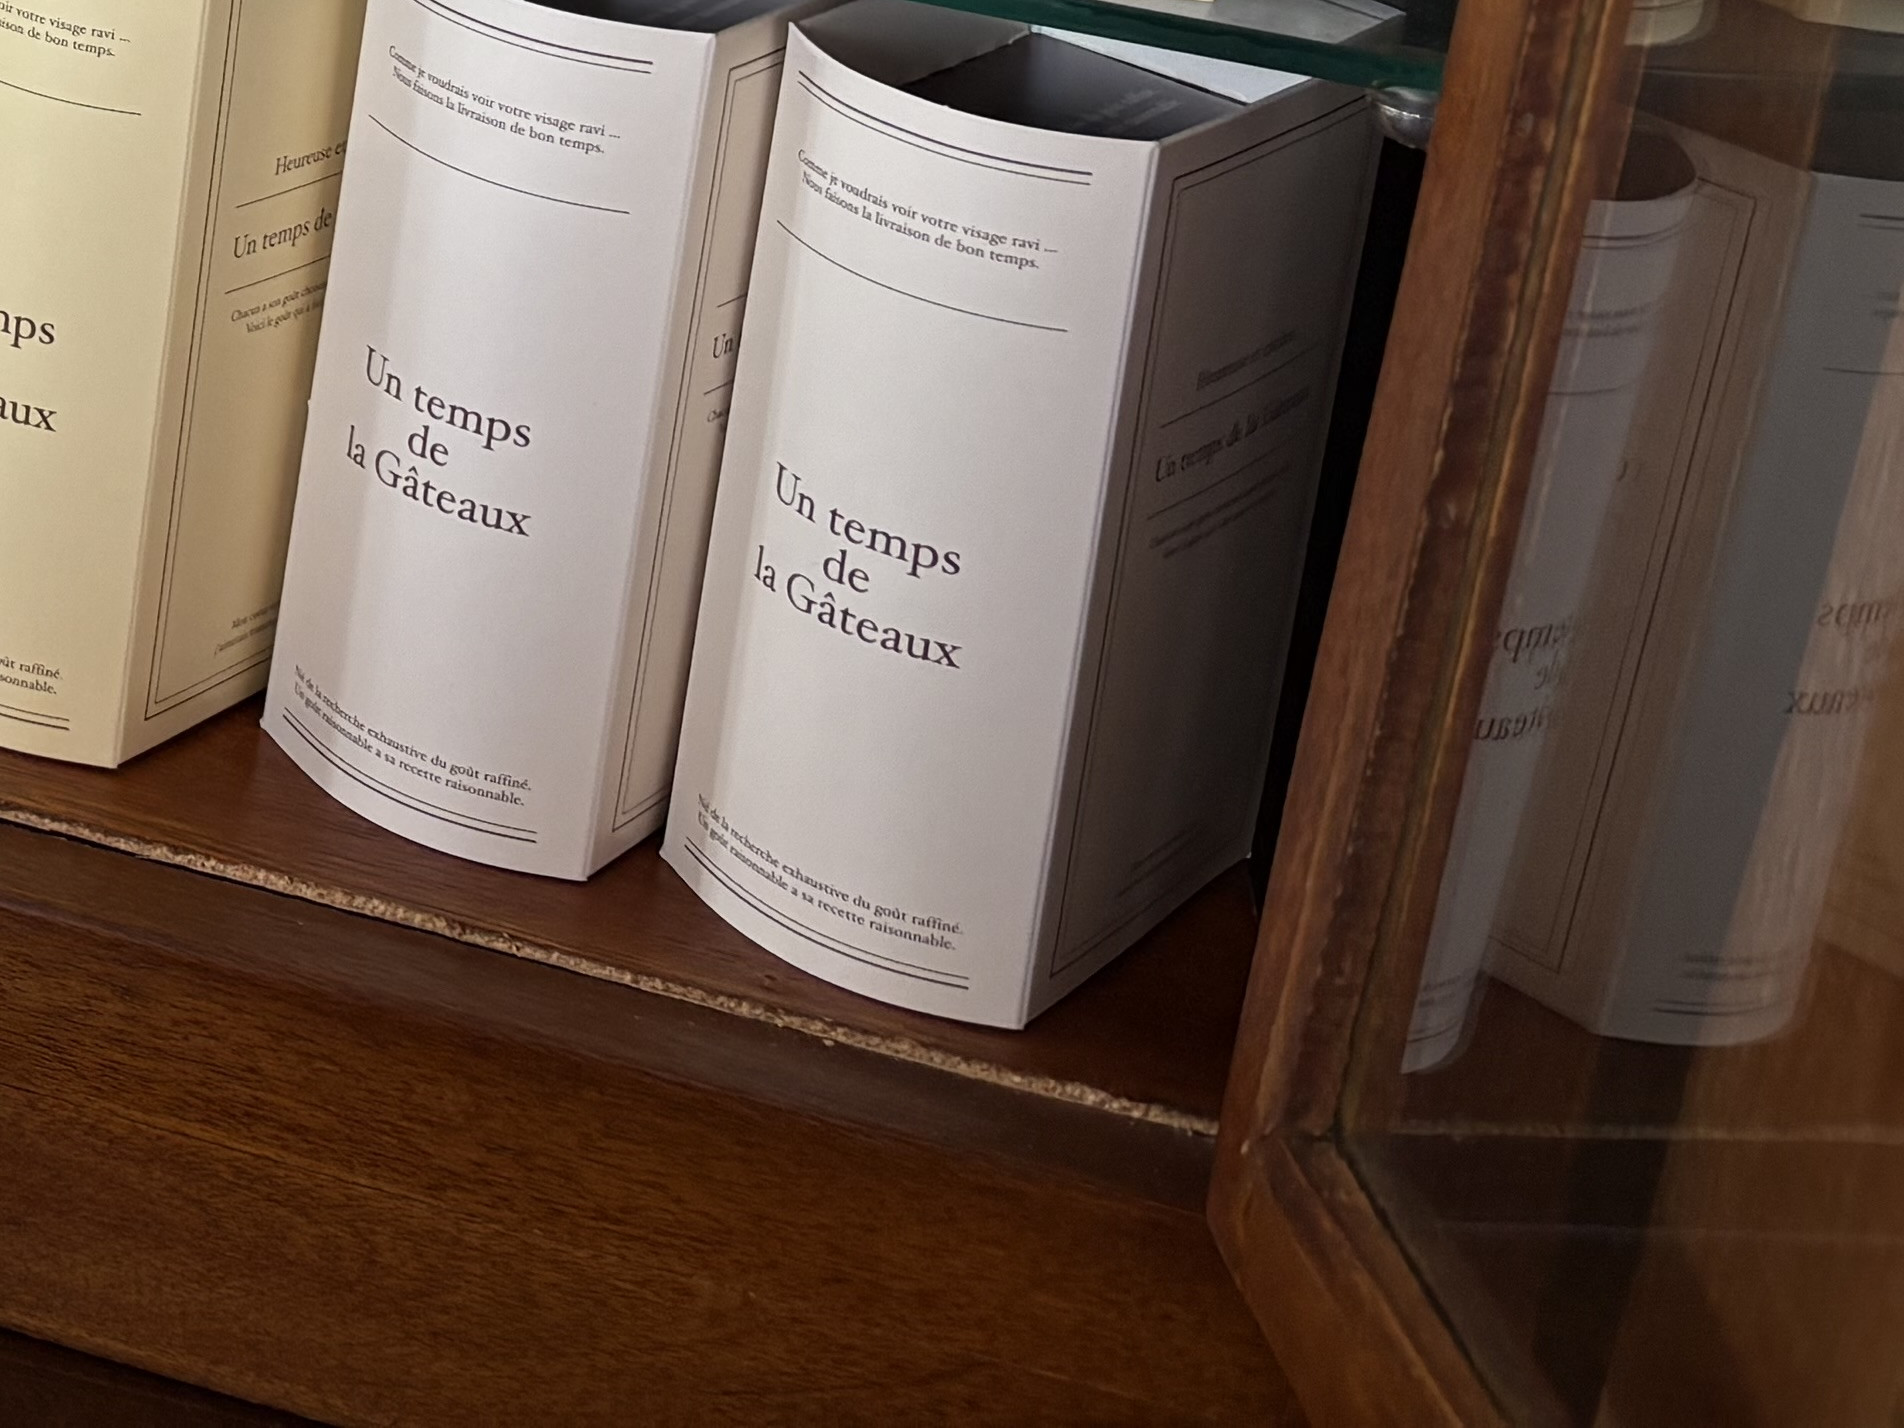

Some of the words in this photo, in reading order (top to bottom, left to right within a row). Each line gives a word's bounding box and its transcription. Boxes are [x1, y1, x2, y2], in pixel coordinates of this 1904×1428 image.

[366, 344, 403, 402] Un
[414, 385, 531, 452] temps
[407, 424, 449, 467] de
[346, 424, 366, 469] la
[374, 449, 532, 537] Gâteaux
[776, 460, 816, 524] Un
[829, 507, 961, 580] temps
[754, 544, 776, 593] la
[786, 573, 963, 670] Gâteaux
[822, 548, 870, 594] de
